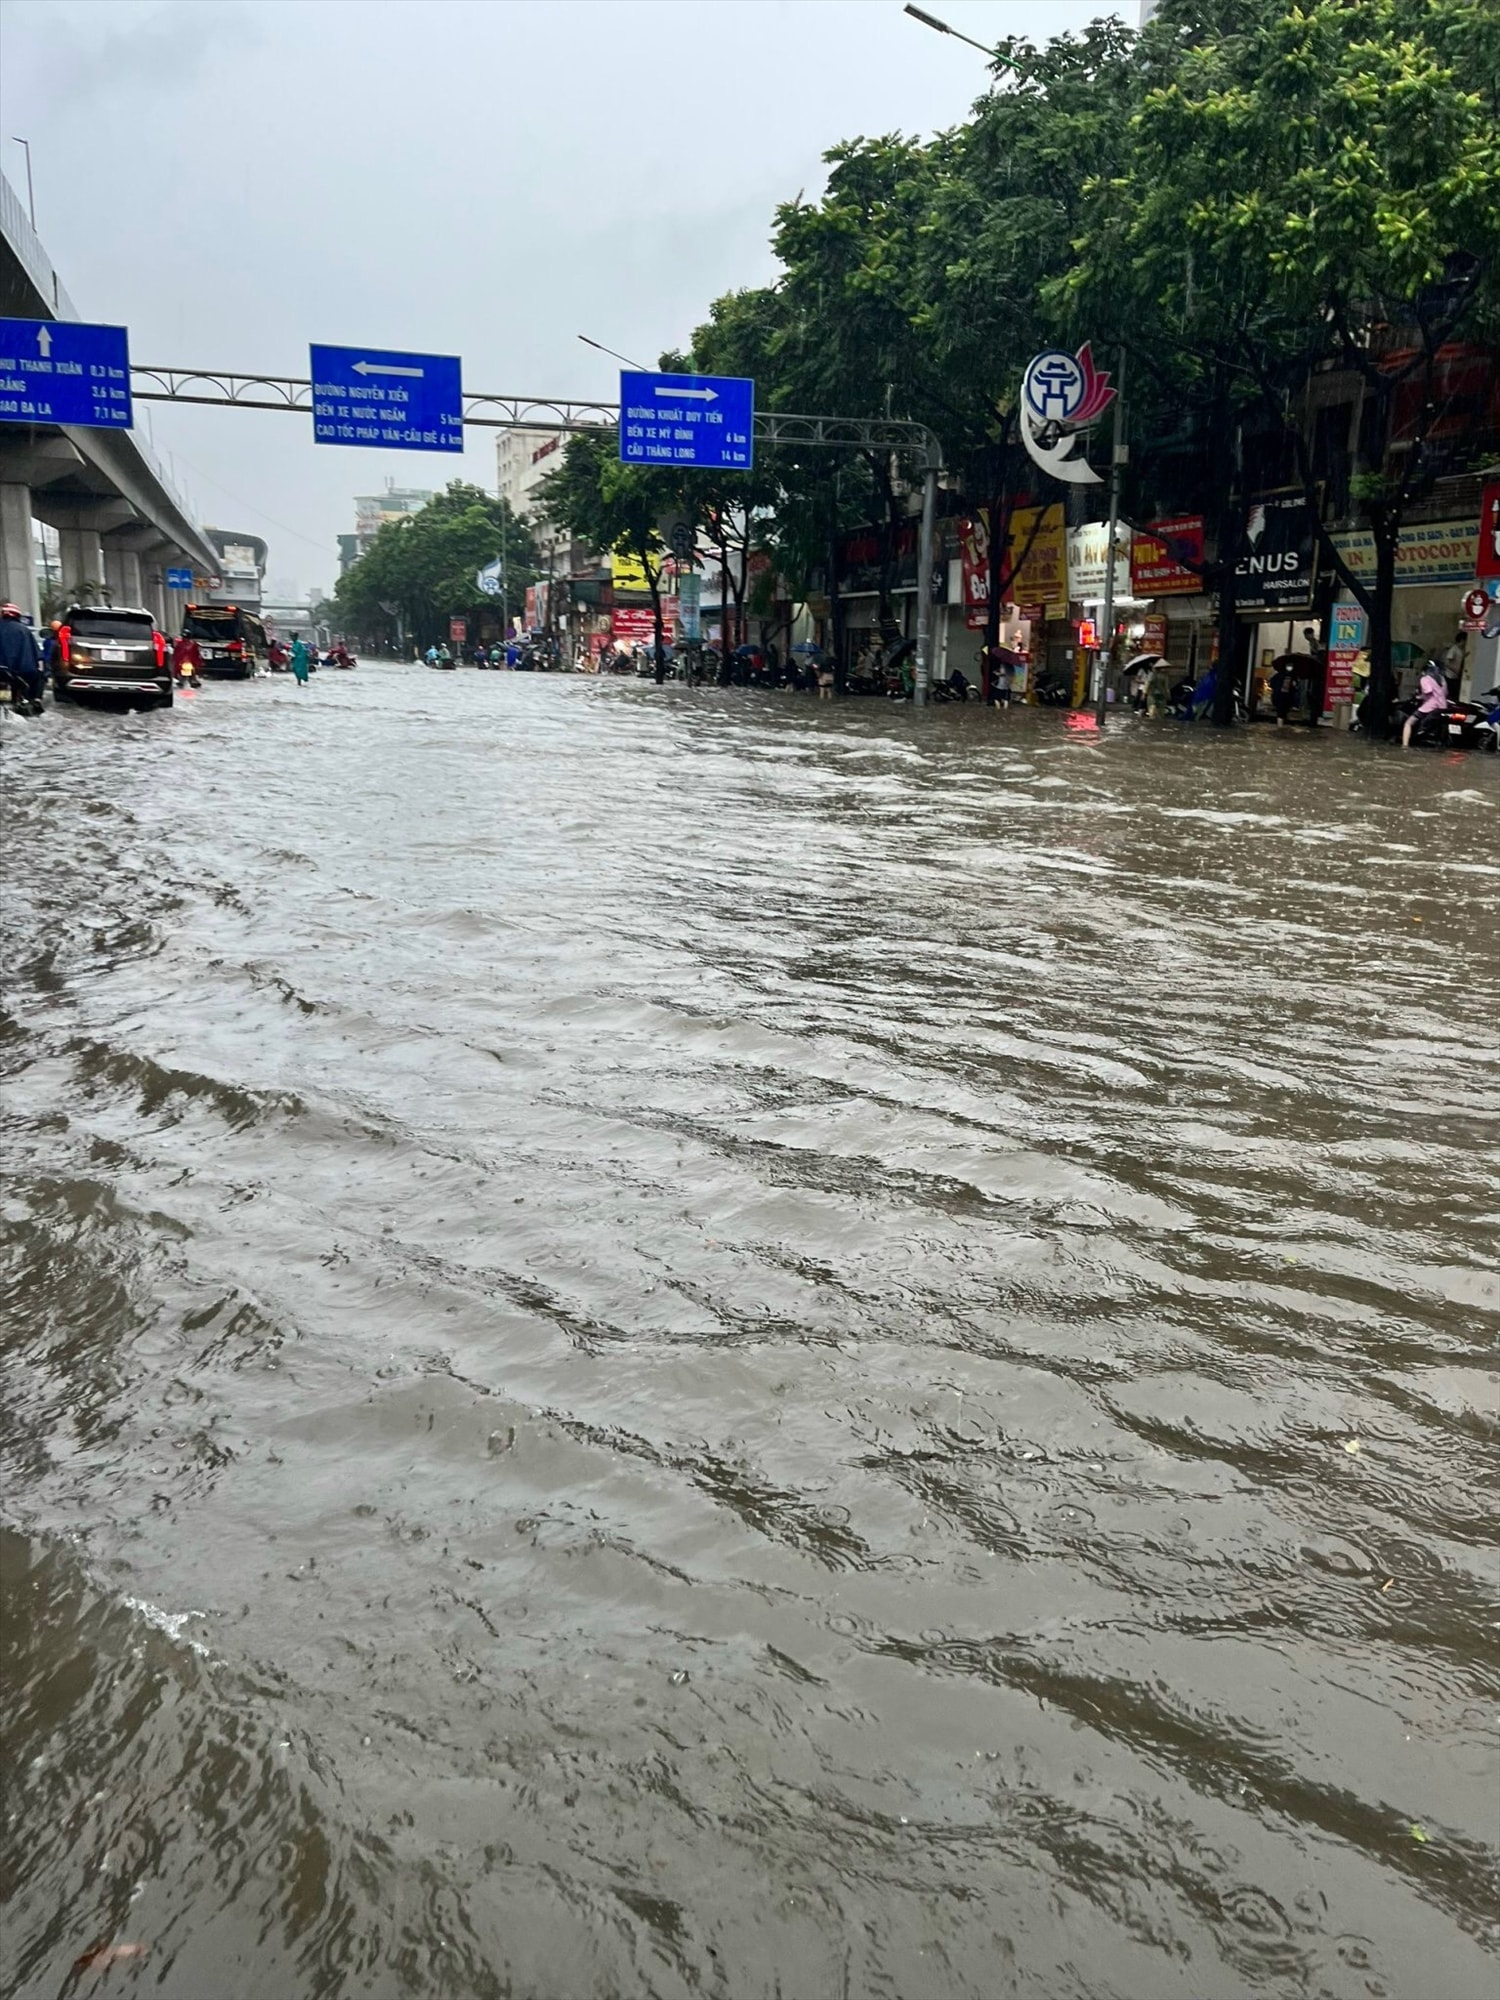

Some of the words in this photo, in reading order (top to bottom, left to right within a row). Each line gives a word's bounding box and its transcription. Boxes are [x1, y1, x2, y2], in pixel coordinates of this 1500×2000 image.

[108, 366, 124, 378] km
[110, 387, 126, 399] km
[314, 381, 346, 397] ĐƯỜNG
[349, 384, 385, 401] NGUYỄN
[21, 402, 35, 414] BA
[38, 402, 52, 414] LA
[111, 408, 128, 420] km
[316, 402, 334, 416] BẾN
[338, 406, 350, 418] XE
[352, 405, 377, 420] NƯỚC
[440, 414, 446, 425] 5
[448, 414, 462, 426] km
[627, 405, 655, 420] ĐƯỜNG
[658, 407, 682, 421] KHUẤT
[686, 412, 702, 422] DUY
[705, 409, 723, 423] TIẾN
[316, 424, 334, 436] CAO
[337, 423, 354, 438] TỐC
[356, 425, 380, 439] PHÁP
[440, 433, 446, 444] 6
[449, 434, 462, 445] km
[627, 424, 643, 437] BẾN
[646, 427, 656, 438] XE
[659, 427, 671, 439] MỸ
[674, 427, 694, 440] ĐÌNH
[726, 433, 732, 442] 6
[733, 433, 746, 443] km
[627, 442, 643, 456] CẦU
[646, 444, 672, 457] THĂNG
[674, 448, 695, 459] LONG
[722, 450, 730, 460] 14
[733, 451, 745, 461] km
[1347, 551, 1364, 565] IN
[1396, 542, 1472, 562] OTOCOPY
[1235, 552, 1299, 575] ENUS
[1338, 624, 1358, 639] IN
